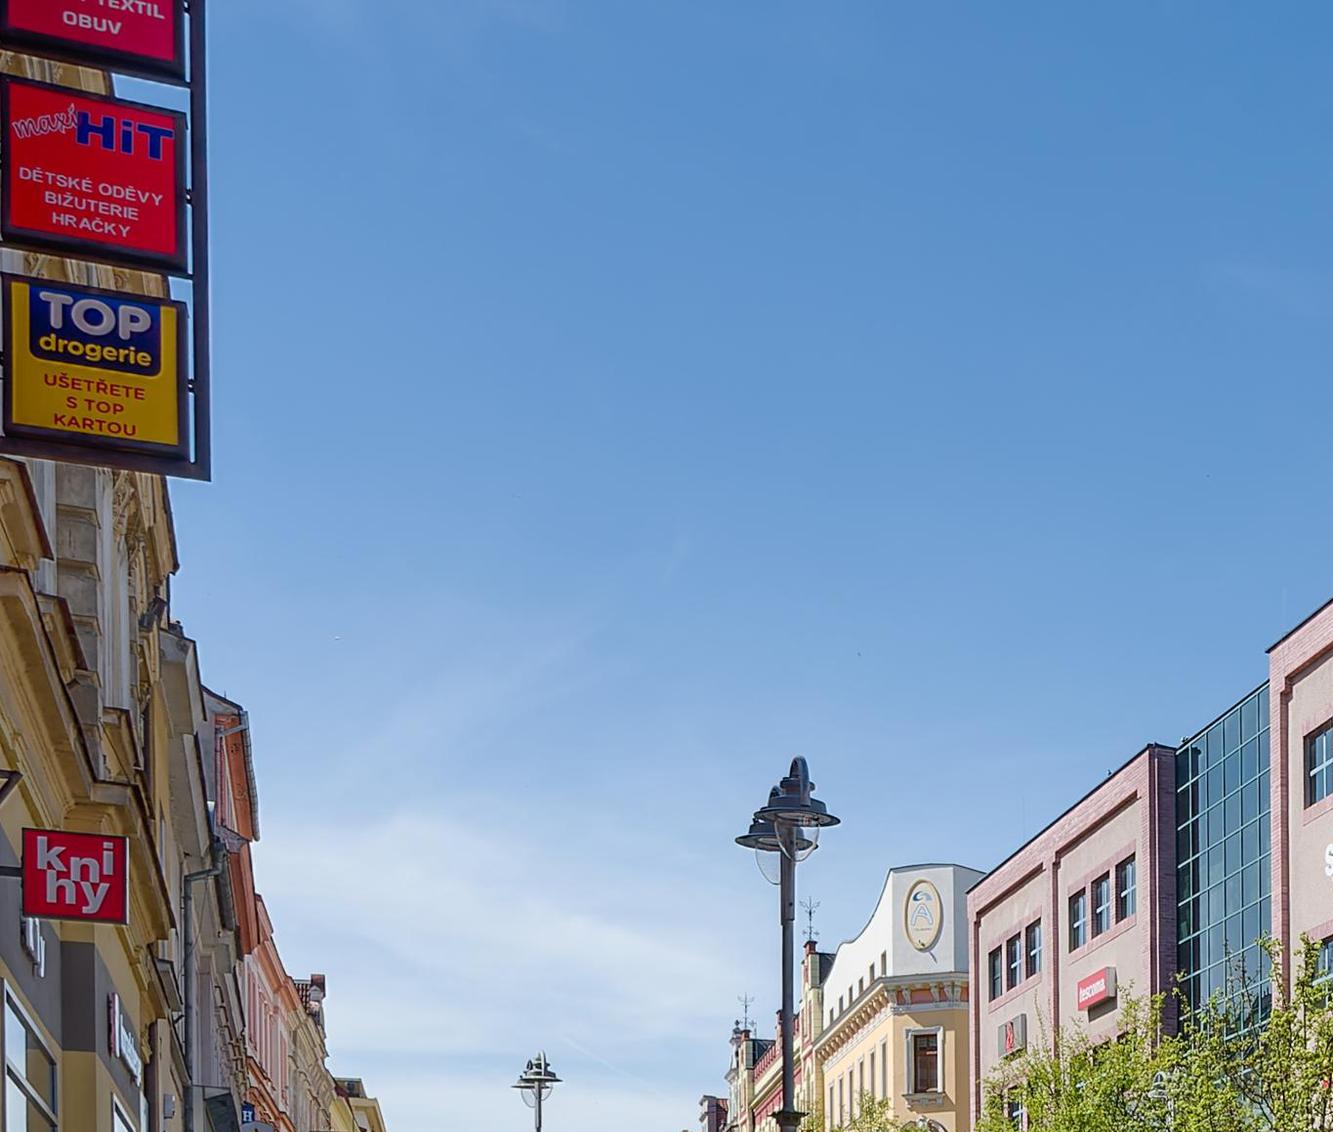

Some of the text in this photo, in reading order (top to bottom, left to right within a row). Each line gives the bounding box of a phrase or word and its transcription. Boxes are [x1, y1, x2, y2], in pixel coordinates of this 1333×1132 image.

[63, 11, 122, 34] OBUV
[12, 103, 79, 139] maxi
[76, 111, 174, 160] HiT
[19, 166, 163, 206] DĚTSKÉ ODĚVY
[44, 191, 139, 221] BIŽUTERIE
[52, 211, 131, 238] HRAČKY
[39, 291, 152, 341] TOP
[39, 333, 152, 367] drogerie
[44, 372, 145, 400] UŠETŘETE
[66, 396, 124, 415] S TOP
[53, 413, 137, 436] KARTOU
[36, 835, 114, 884] kni
[46, 869, 110, 914] hy
